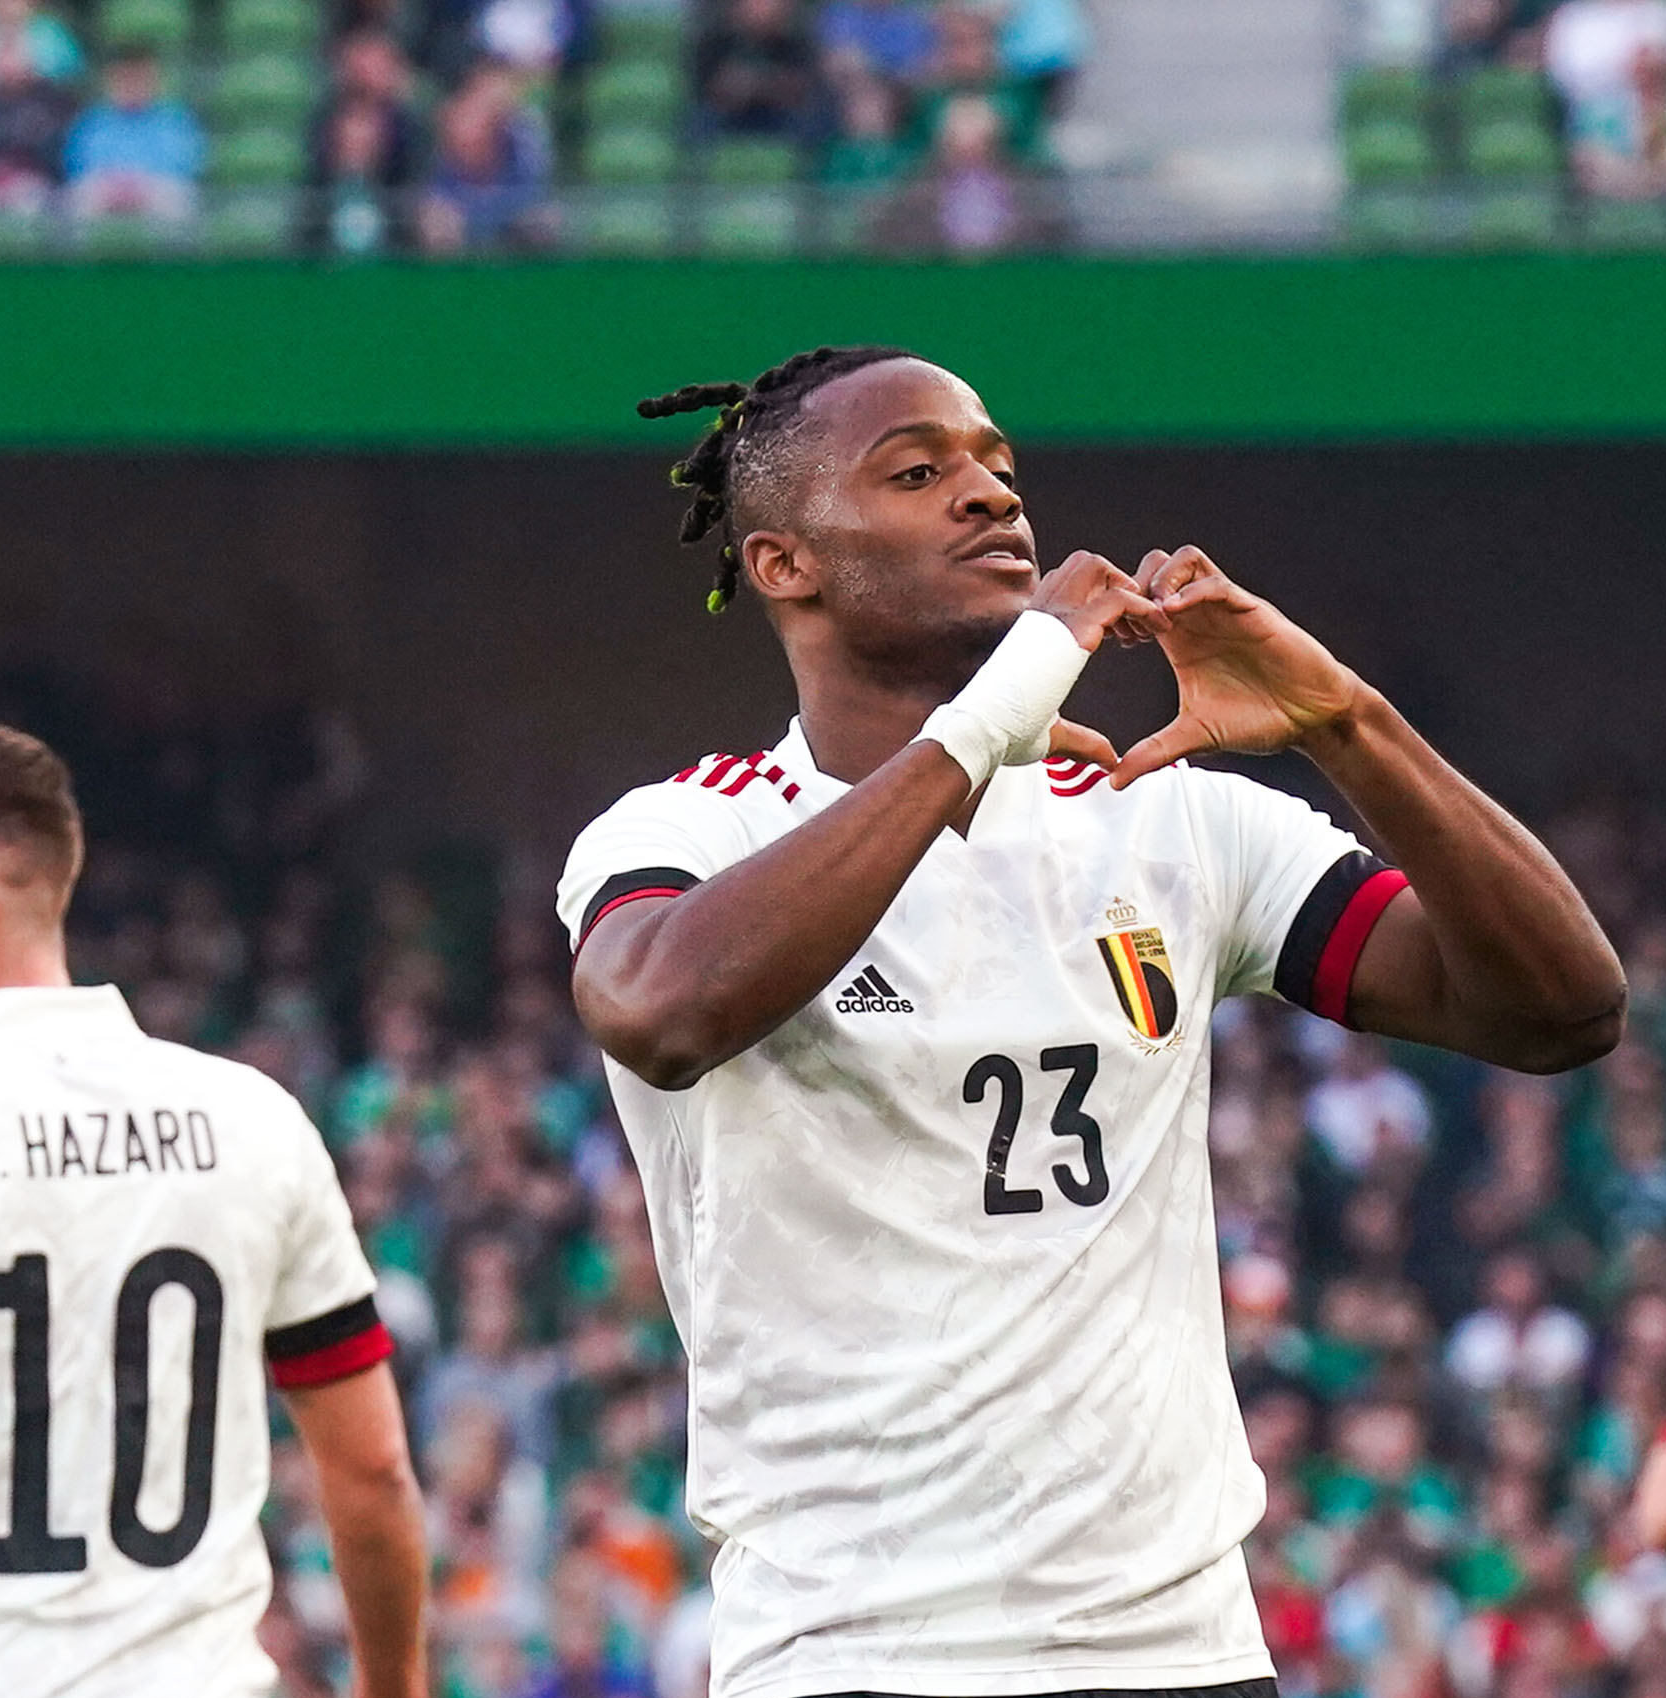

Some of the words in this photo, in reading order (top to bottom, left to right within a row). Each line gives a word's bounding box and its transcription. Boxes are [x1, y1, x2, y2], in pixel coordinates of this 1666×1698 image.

[836, 994, 915, 1014] adidas
[19, 1108, 217, 1178] HAZARD
[962, 1043, 1110, 1215] 23
